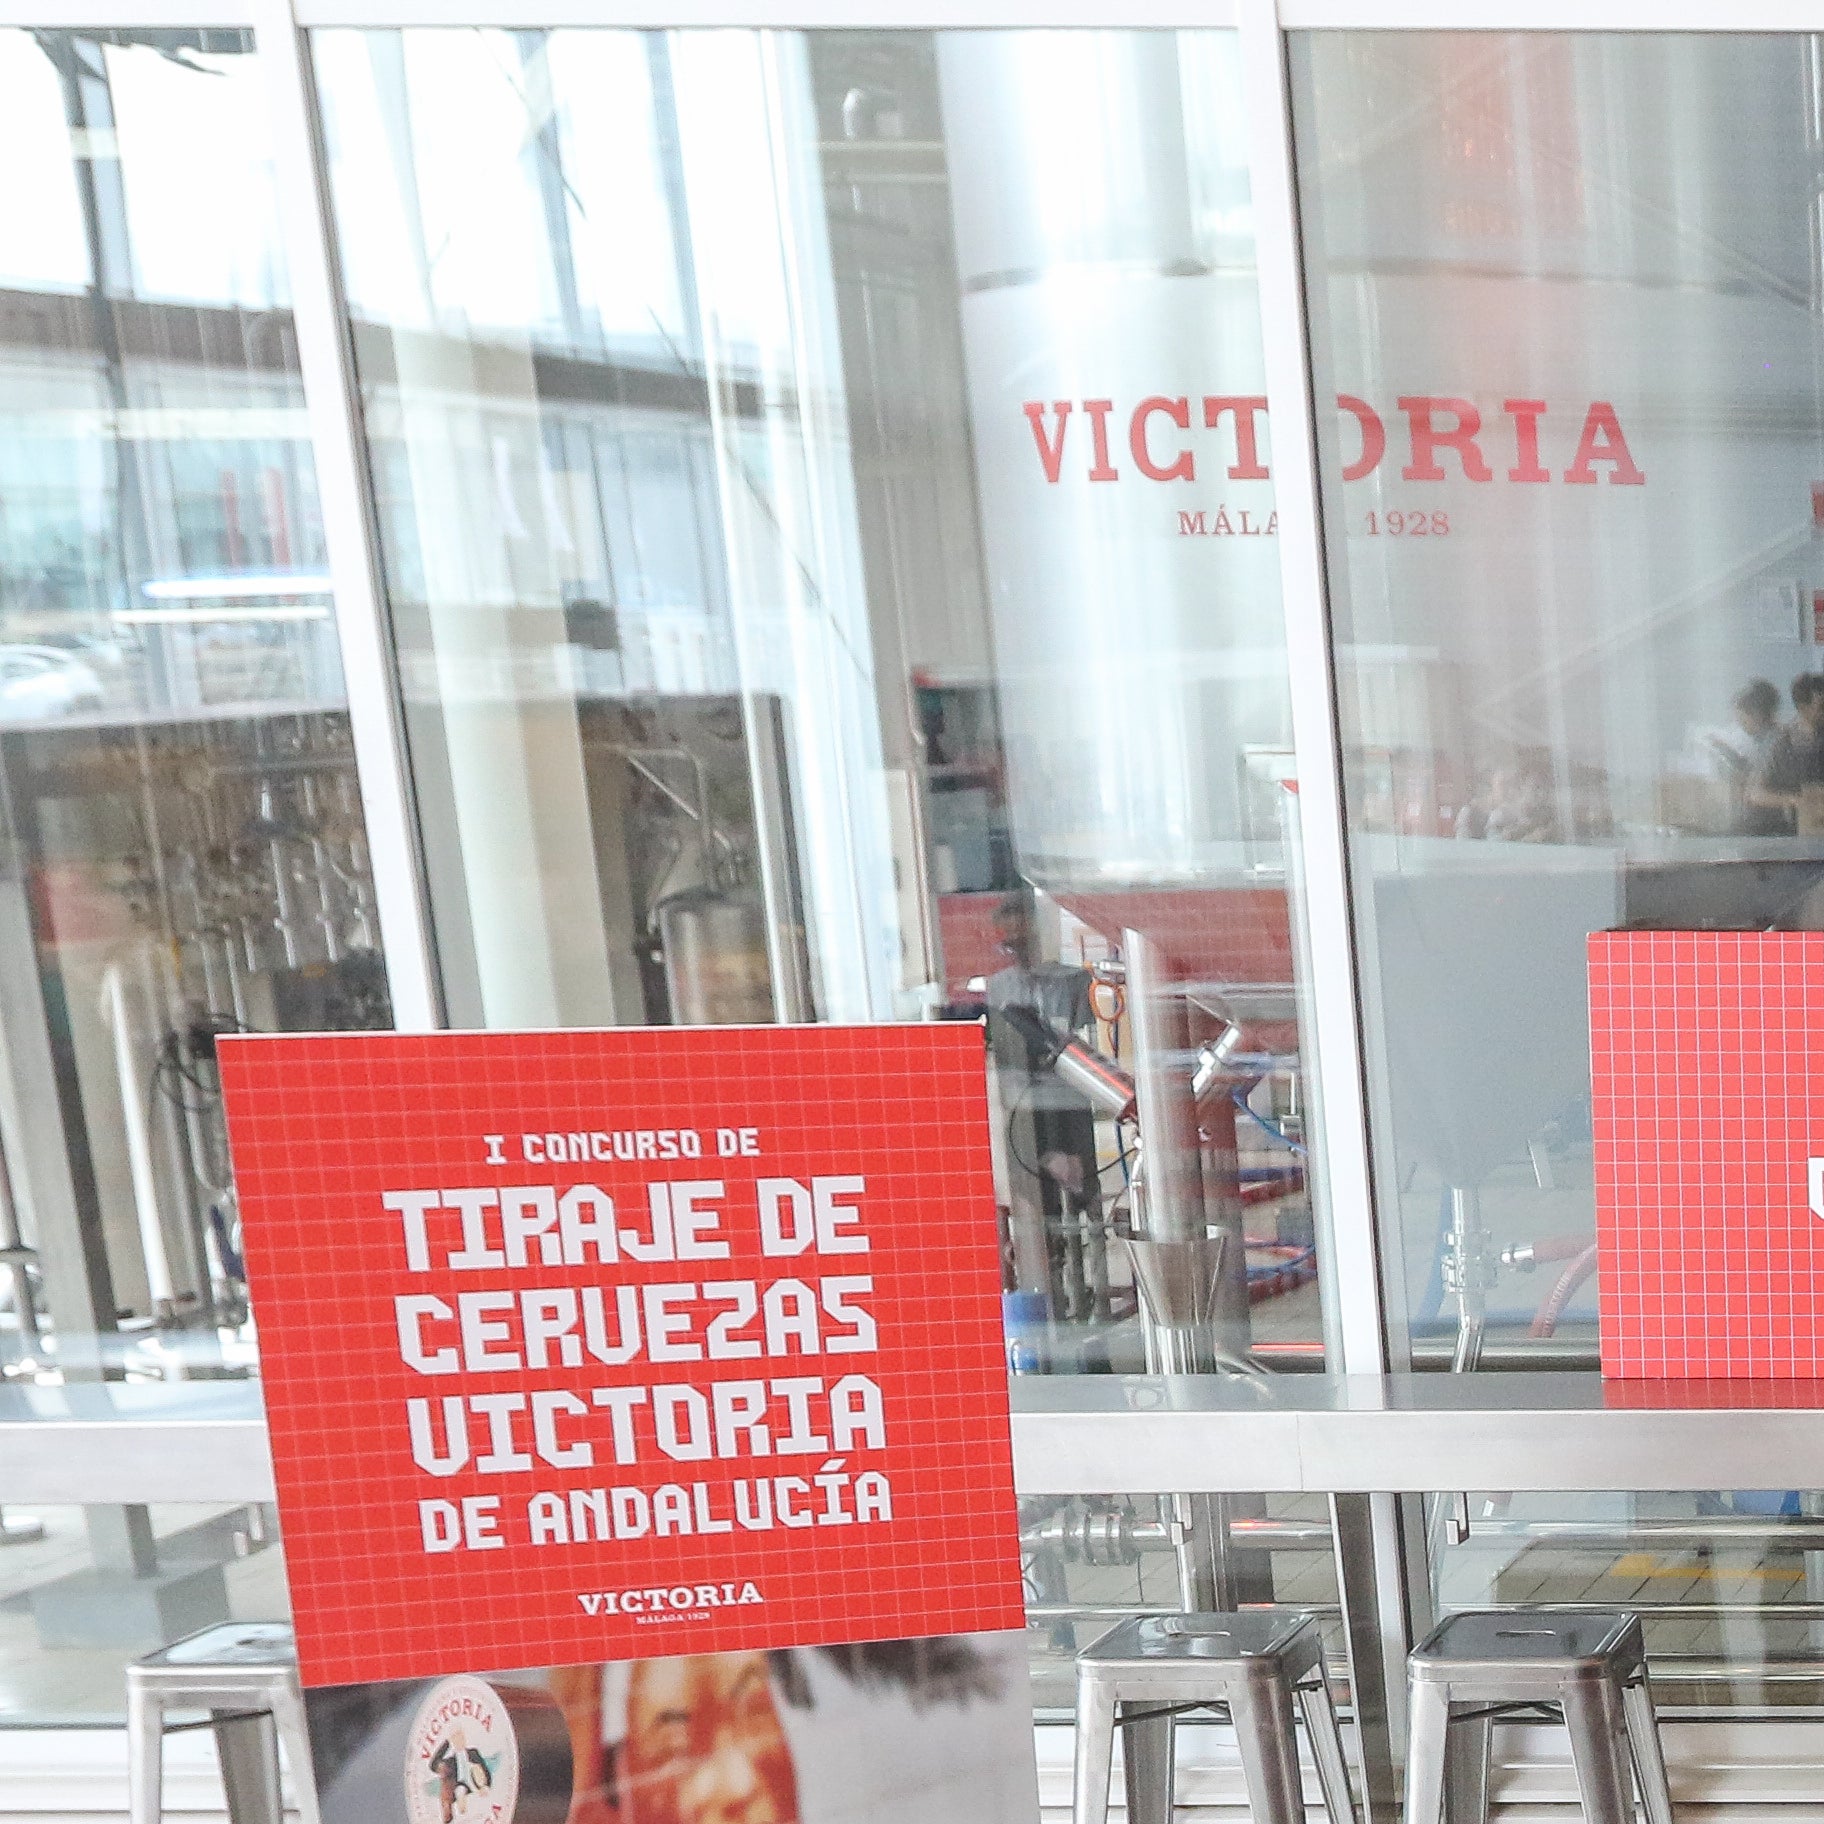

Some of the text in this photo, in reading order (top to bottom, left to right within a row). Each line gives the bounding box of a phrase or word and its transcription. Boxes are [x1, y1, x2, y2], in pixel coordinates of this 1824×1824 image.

[1178, 504, 1449, 536] MÁLA 1928
[484, 1127, 760, 1165] I CONCURSO DE
[382, 1175, 870, 1272] TIRAJE DE
[395, 1275, 878, 1375] CERVEZAS
[407, 1374, 886, 1477] VICTORIA
[419, 1459, 892, 1554] DE ANDALUCÍA
[577, 1582, 764, 1616] VICTORIA
[421, 1698, 493, 1760] VICTORIA
